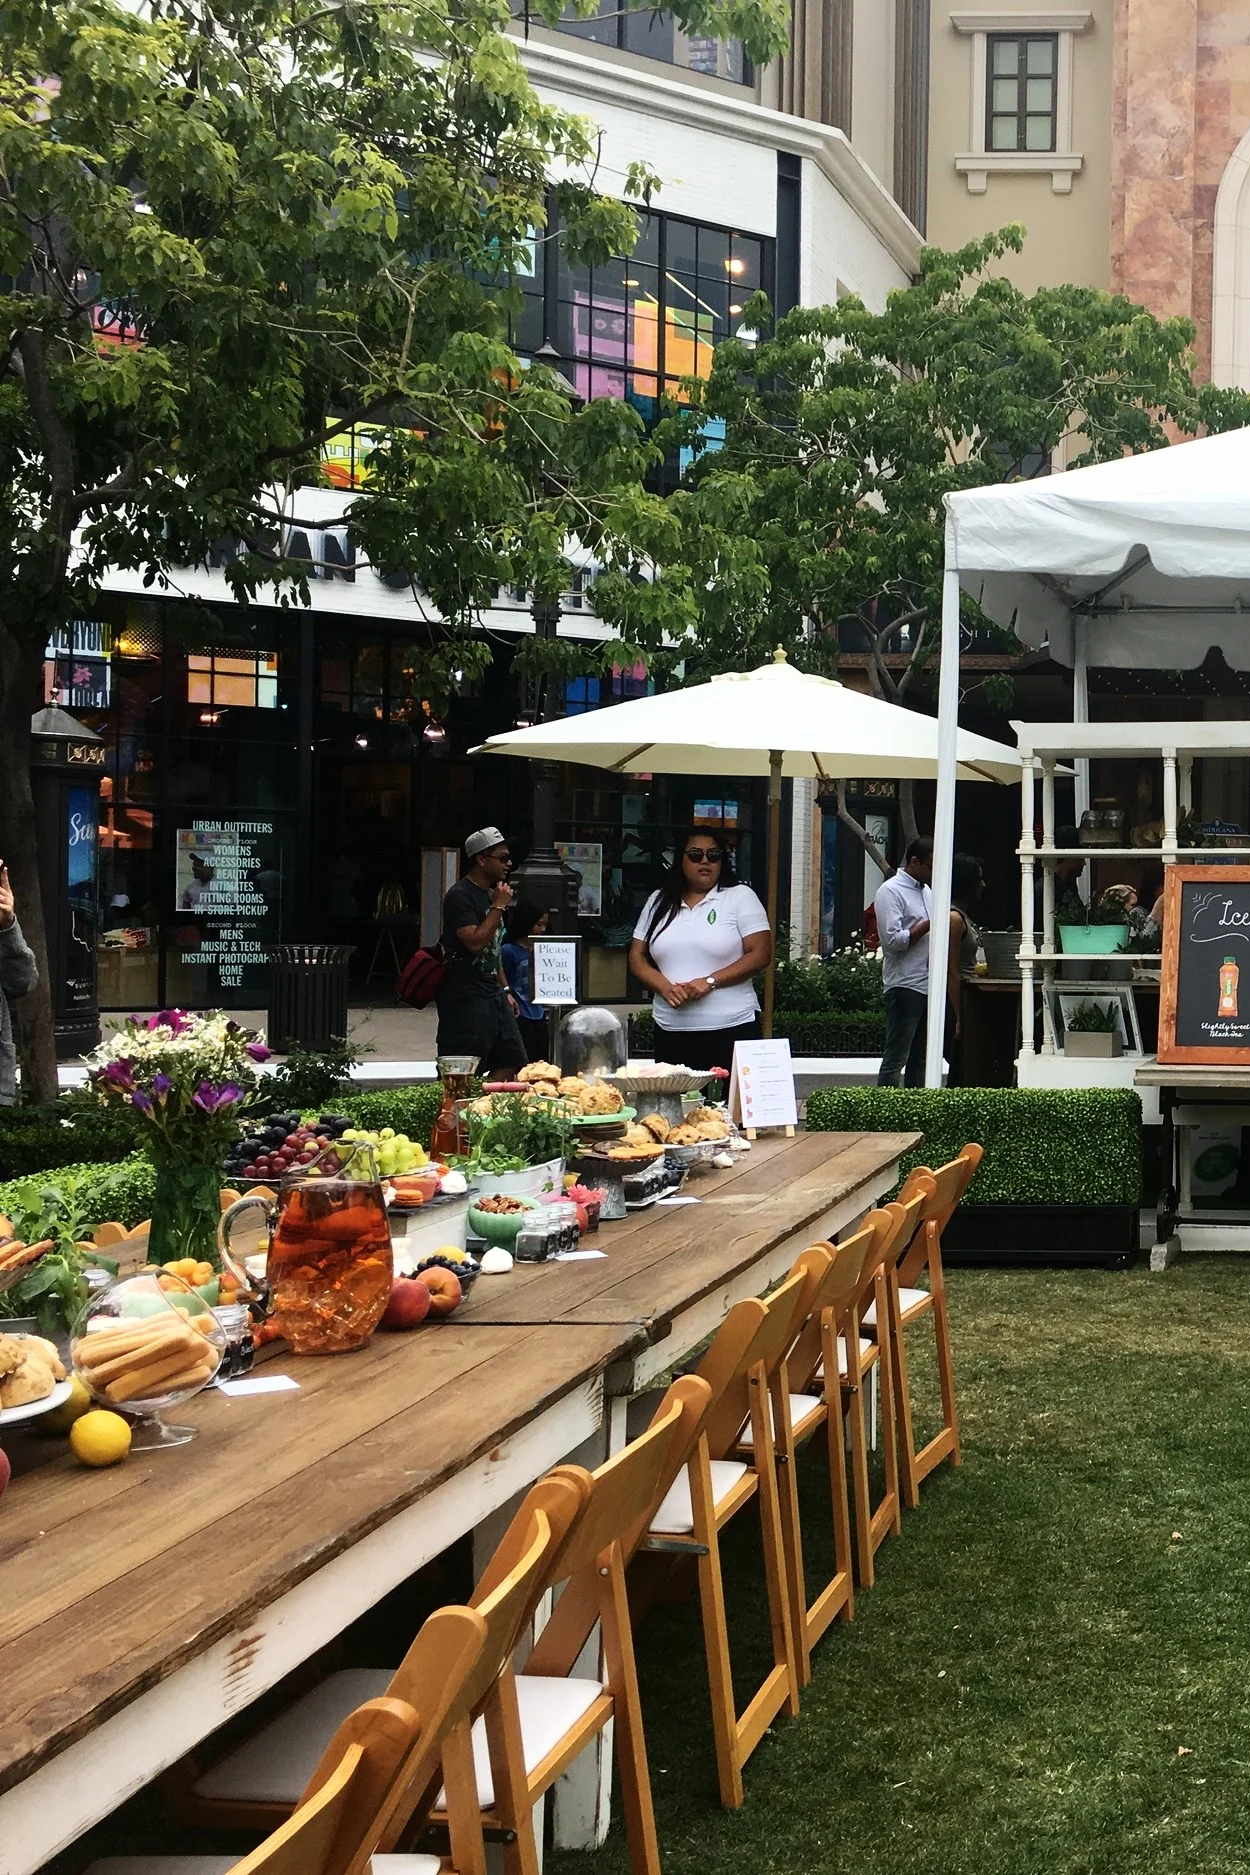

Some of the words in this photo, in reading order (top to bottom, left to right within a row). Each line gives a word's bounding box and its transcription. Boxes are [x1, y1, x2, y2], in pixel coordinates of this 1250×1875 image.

[192, 820, 221, 832] URBAN
[224, 821, 273, 833] OUTFITTERS
[213, 845, 252, 856] WOMENS
[203, 857, 261, 868] ACCESSORIES
[216, 869, 249, 880] BEAUTY
[209, 881, 254, 892] INTIMATES
[199, 892, 232, 903] FITTING
[234, 893, 264, 904] ROOMS
[194, 904, 235, 915] IN-STORE
[237, 905, 268, 916] PICKUP
[219, 929, 243, 940] MENS
[201, 941, 228, 952] MUSIC
[230, 942, 238, 952] &
[239, 941, 261, 952] TECH
[539, 944, 571, 954] Please
[181, 953, 217, 963] INSTANT
[542, 958, 568, 968] Wait
[218, 965, 244, 975] HOME
[220, 976, 242, 986] SALE
[538, 972, 555, 983] To
[558, 972, 572, 983] Be
[539, 987, 573, 997] Seated
